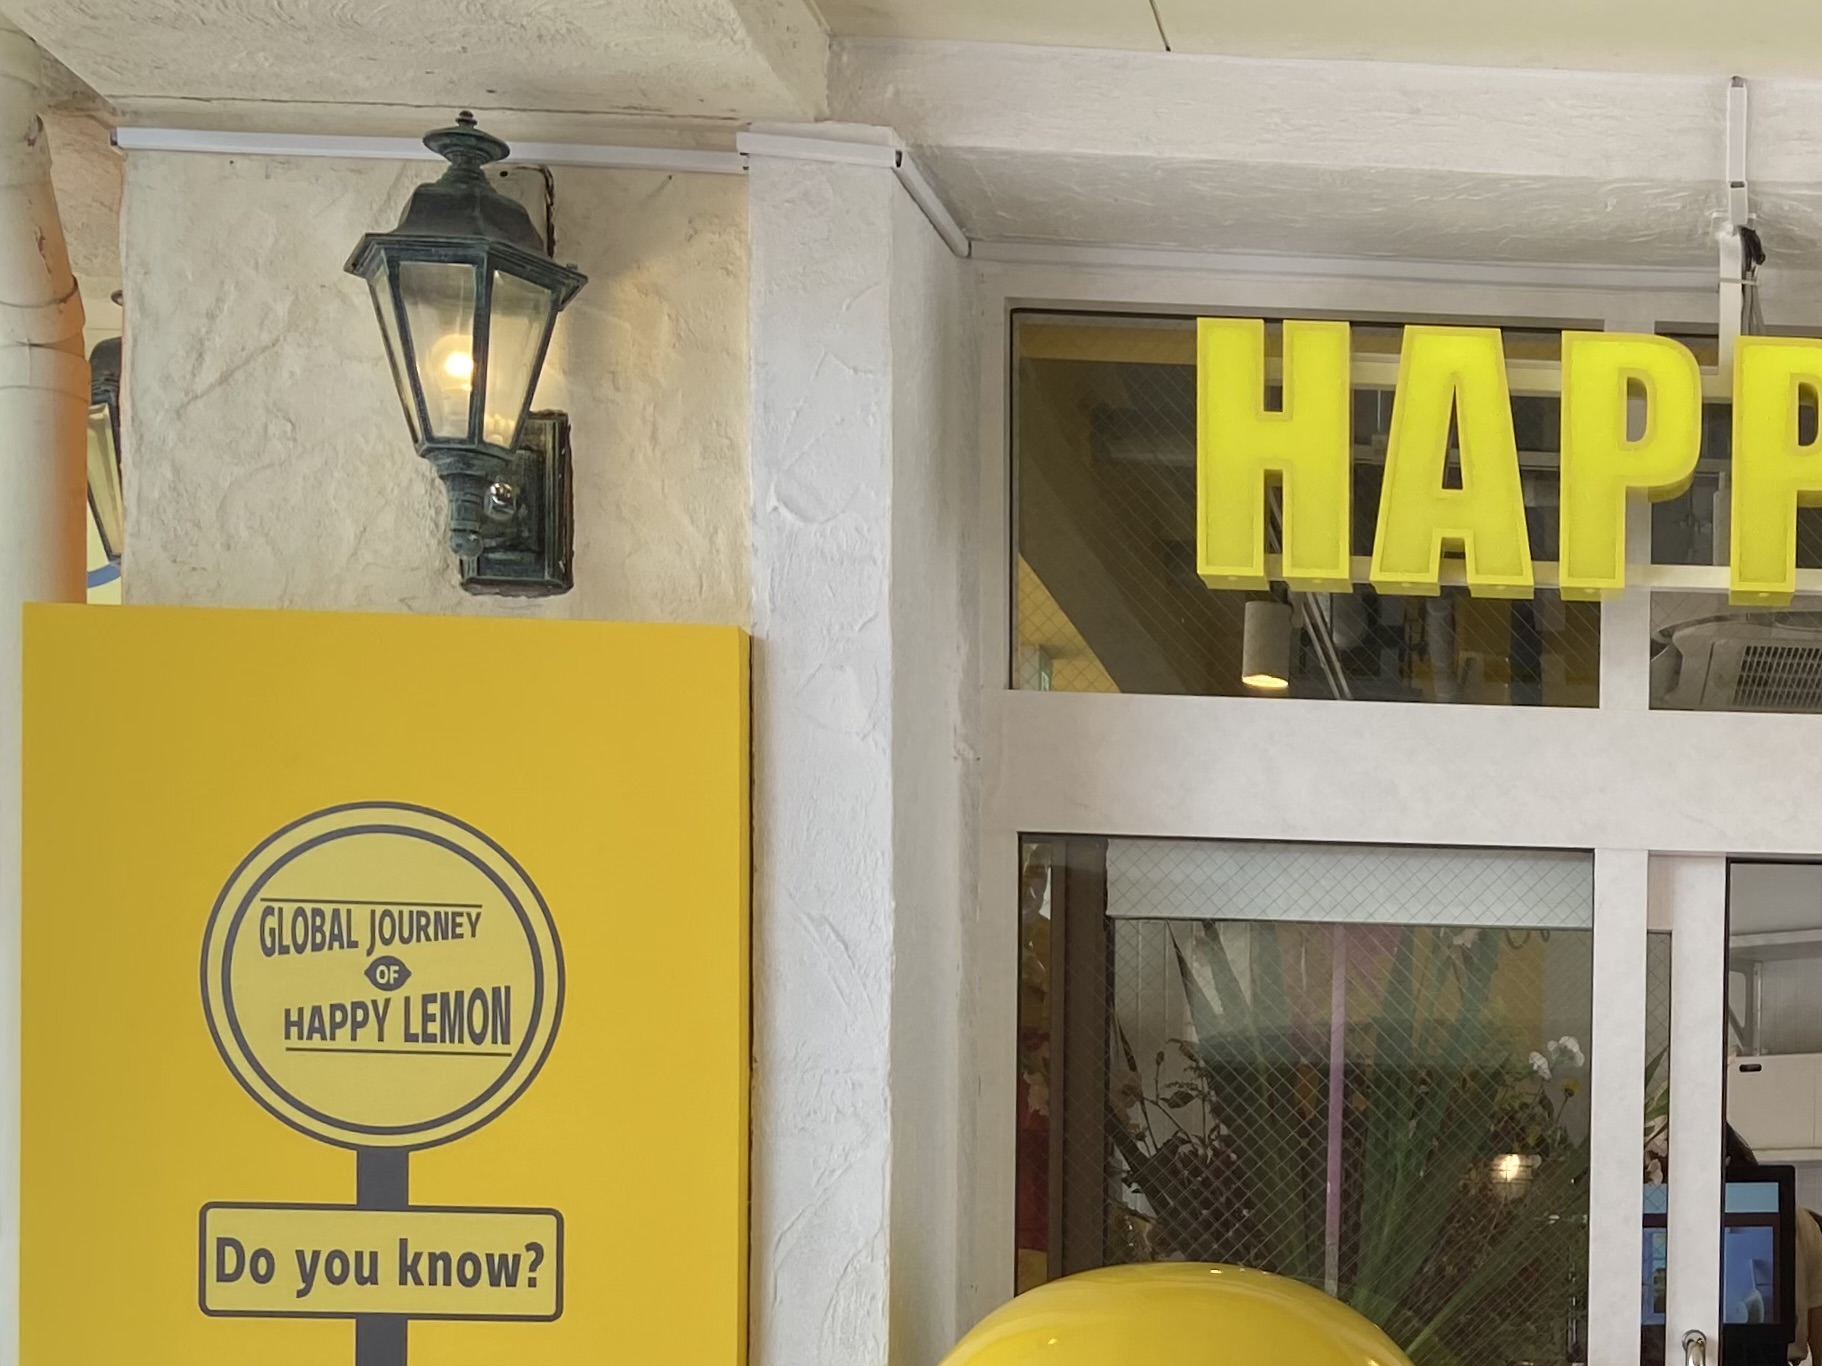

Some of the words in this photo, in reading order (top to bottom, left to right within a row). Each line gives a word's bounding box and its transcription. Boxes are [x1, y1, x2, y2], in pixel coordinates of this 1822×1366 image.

[260, 905, 358, 957] GLOBAL
[366, 911, 481, 957] JOURNEY
[375, 965, 400, 985] OF
[284, 997, 391, 1042] HAPPY
[403, 985, 511, 1046] LEMON
[216, 1237, 275, 1284] Do
[295, 1249, 379, 1298] you
[399, 1238, 544, 1288] know?
